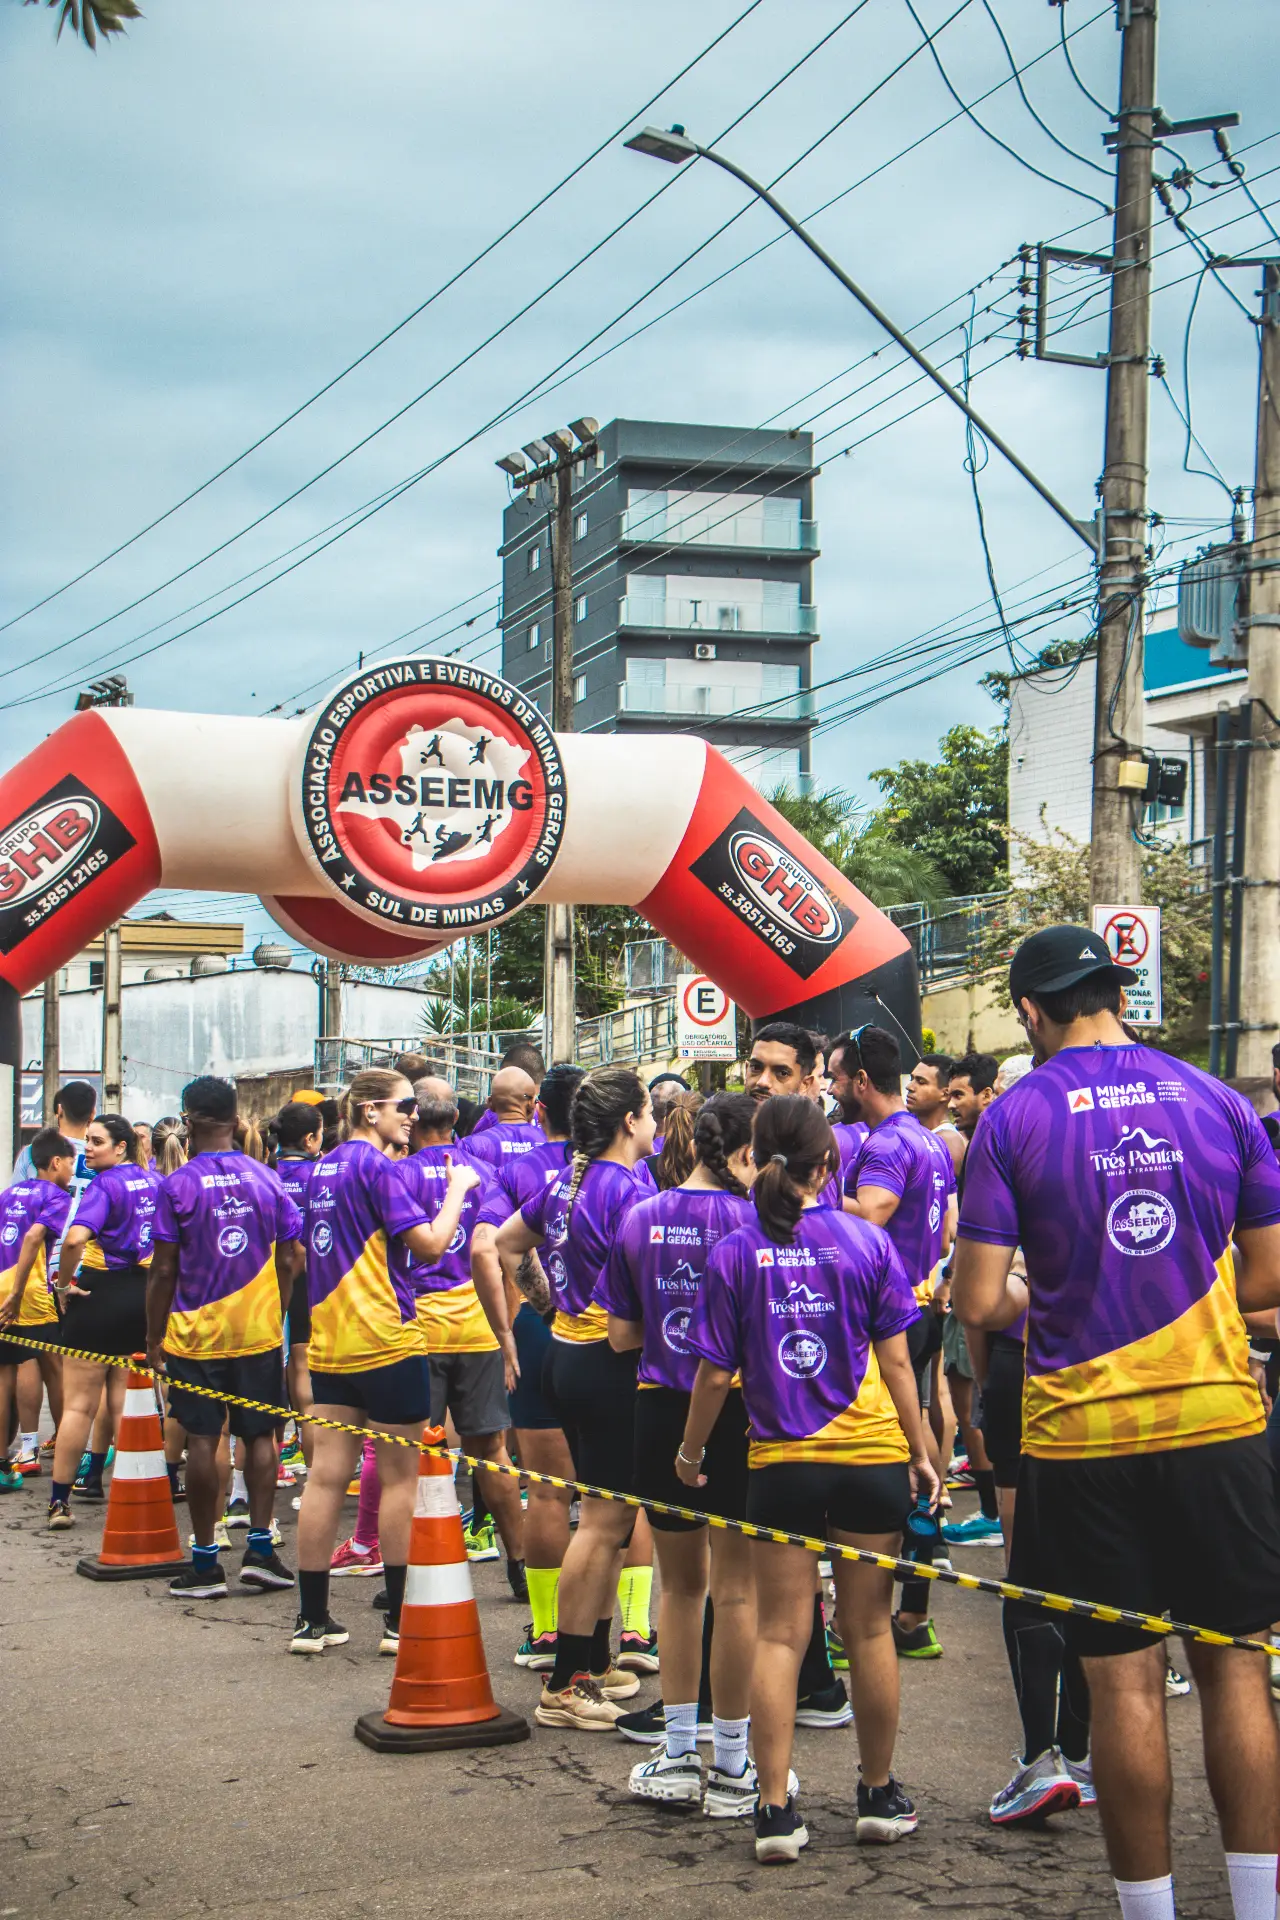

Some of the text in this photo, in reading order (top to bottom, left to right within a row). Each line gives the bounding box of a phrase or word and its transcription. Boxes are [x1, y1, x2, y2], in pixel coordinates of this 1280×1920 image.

[310, 664, 563, 866] ASSOCIAÇÃO ESPORTIVA E EVENTOS DE MINAS GERAIS
[339, 772, 533, 810] ASSEEMG
[1, 821, 39, 857] GRUPO
[0, 808, 92, 900] GHB
[778, 856, 813, 892] GRUPO
[24, 849, 108, 927] 35.3851.2165
[738, 842, 830, 936] GHB
[366, 890, 506, 924] SUL DE MINAS
[718, 882, 796, 955] 35.3851.2165
[698, 988, 715, 1013] E
[1096, 1082, 1146, 1097] MINAS
[1099, 1092, 1156, 1108] GERAIS
[1090, 1148, 1184, 1171] Três Pontas
[1135, 1165, 1172, 1173] TRABALHO
[668, 1226, 698, 1236] MINAS
[1114, 1215, 1169, 1229] ASSEEMG
[667, 1236, 702, 1245] GERAIS
[776, 1248, 810, 1256] MINAS
[777, 1257, 816, 1266] GERAIS
[656, 1278, 679, 1289] Três
[769, 1300, 836, 1314] Três Pontas
